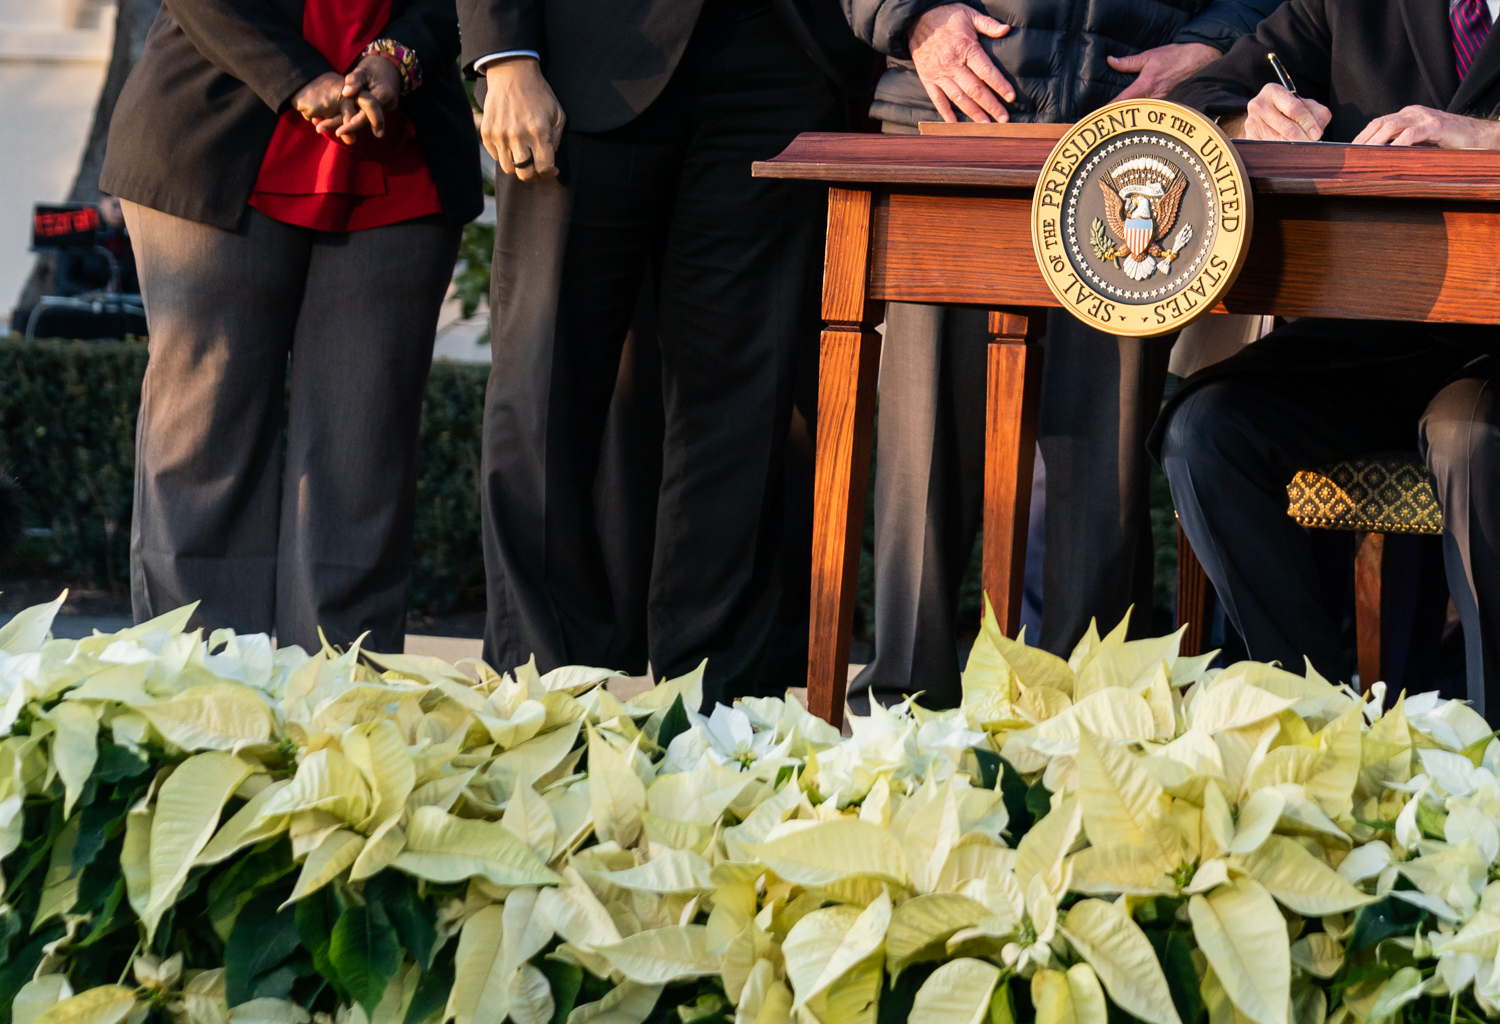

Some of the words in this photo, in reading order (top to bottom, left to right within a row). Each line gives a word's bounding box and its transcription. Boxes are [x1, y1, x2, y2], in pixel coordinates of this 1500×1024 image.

[1147, 110, 1166, 124] OF
[1170, 115, 1196, 139] THE
[1041, 107, 1140, 209] PRESIDENT
[1200, 135, 1240, 233] UNITED
[1043, 218, 1058, 250] THE
[1048, 254, 1065, 273] OF
[1063, 273, 1115, 322] SEAL
[1153, 254, 1228, 324] STATES
